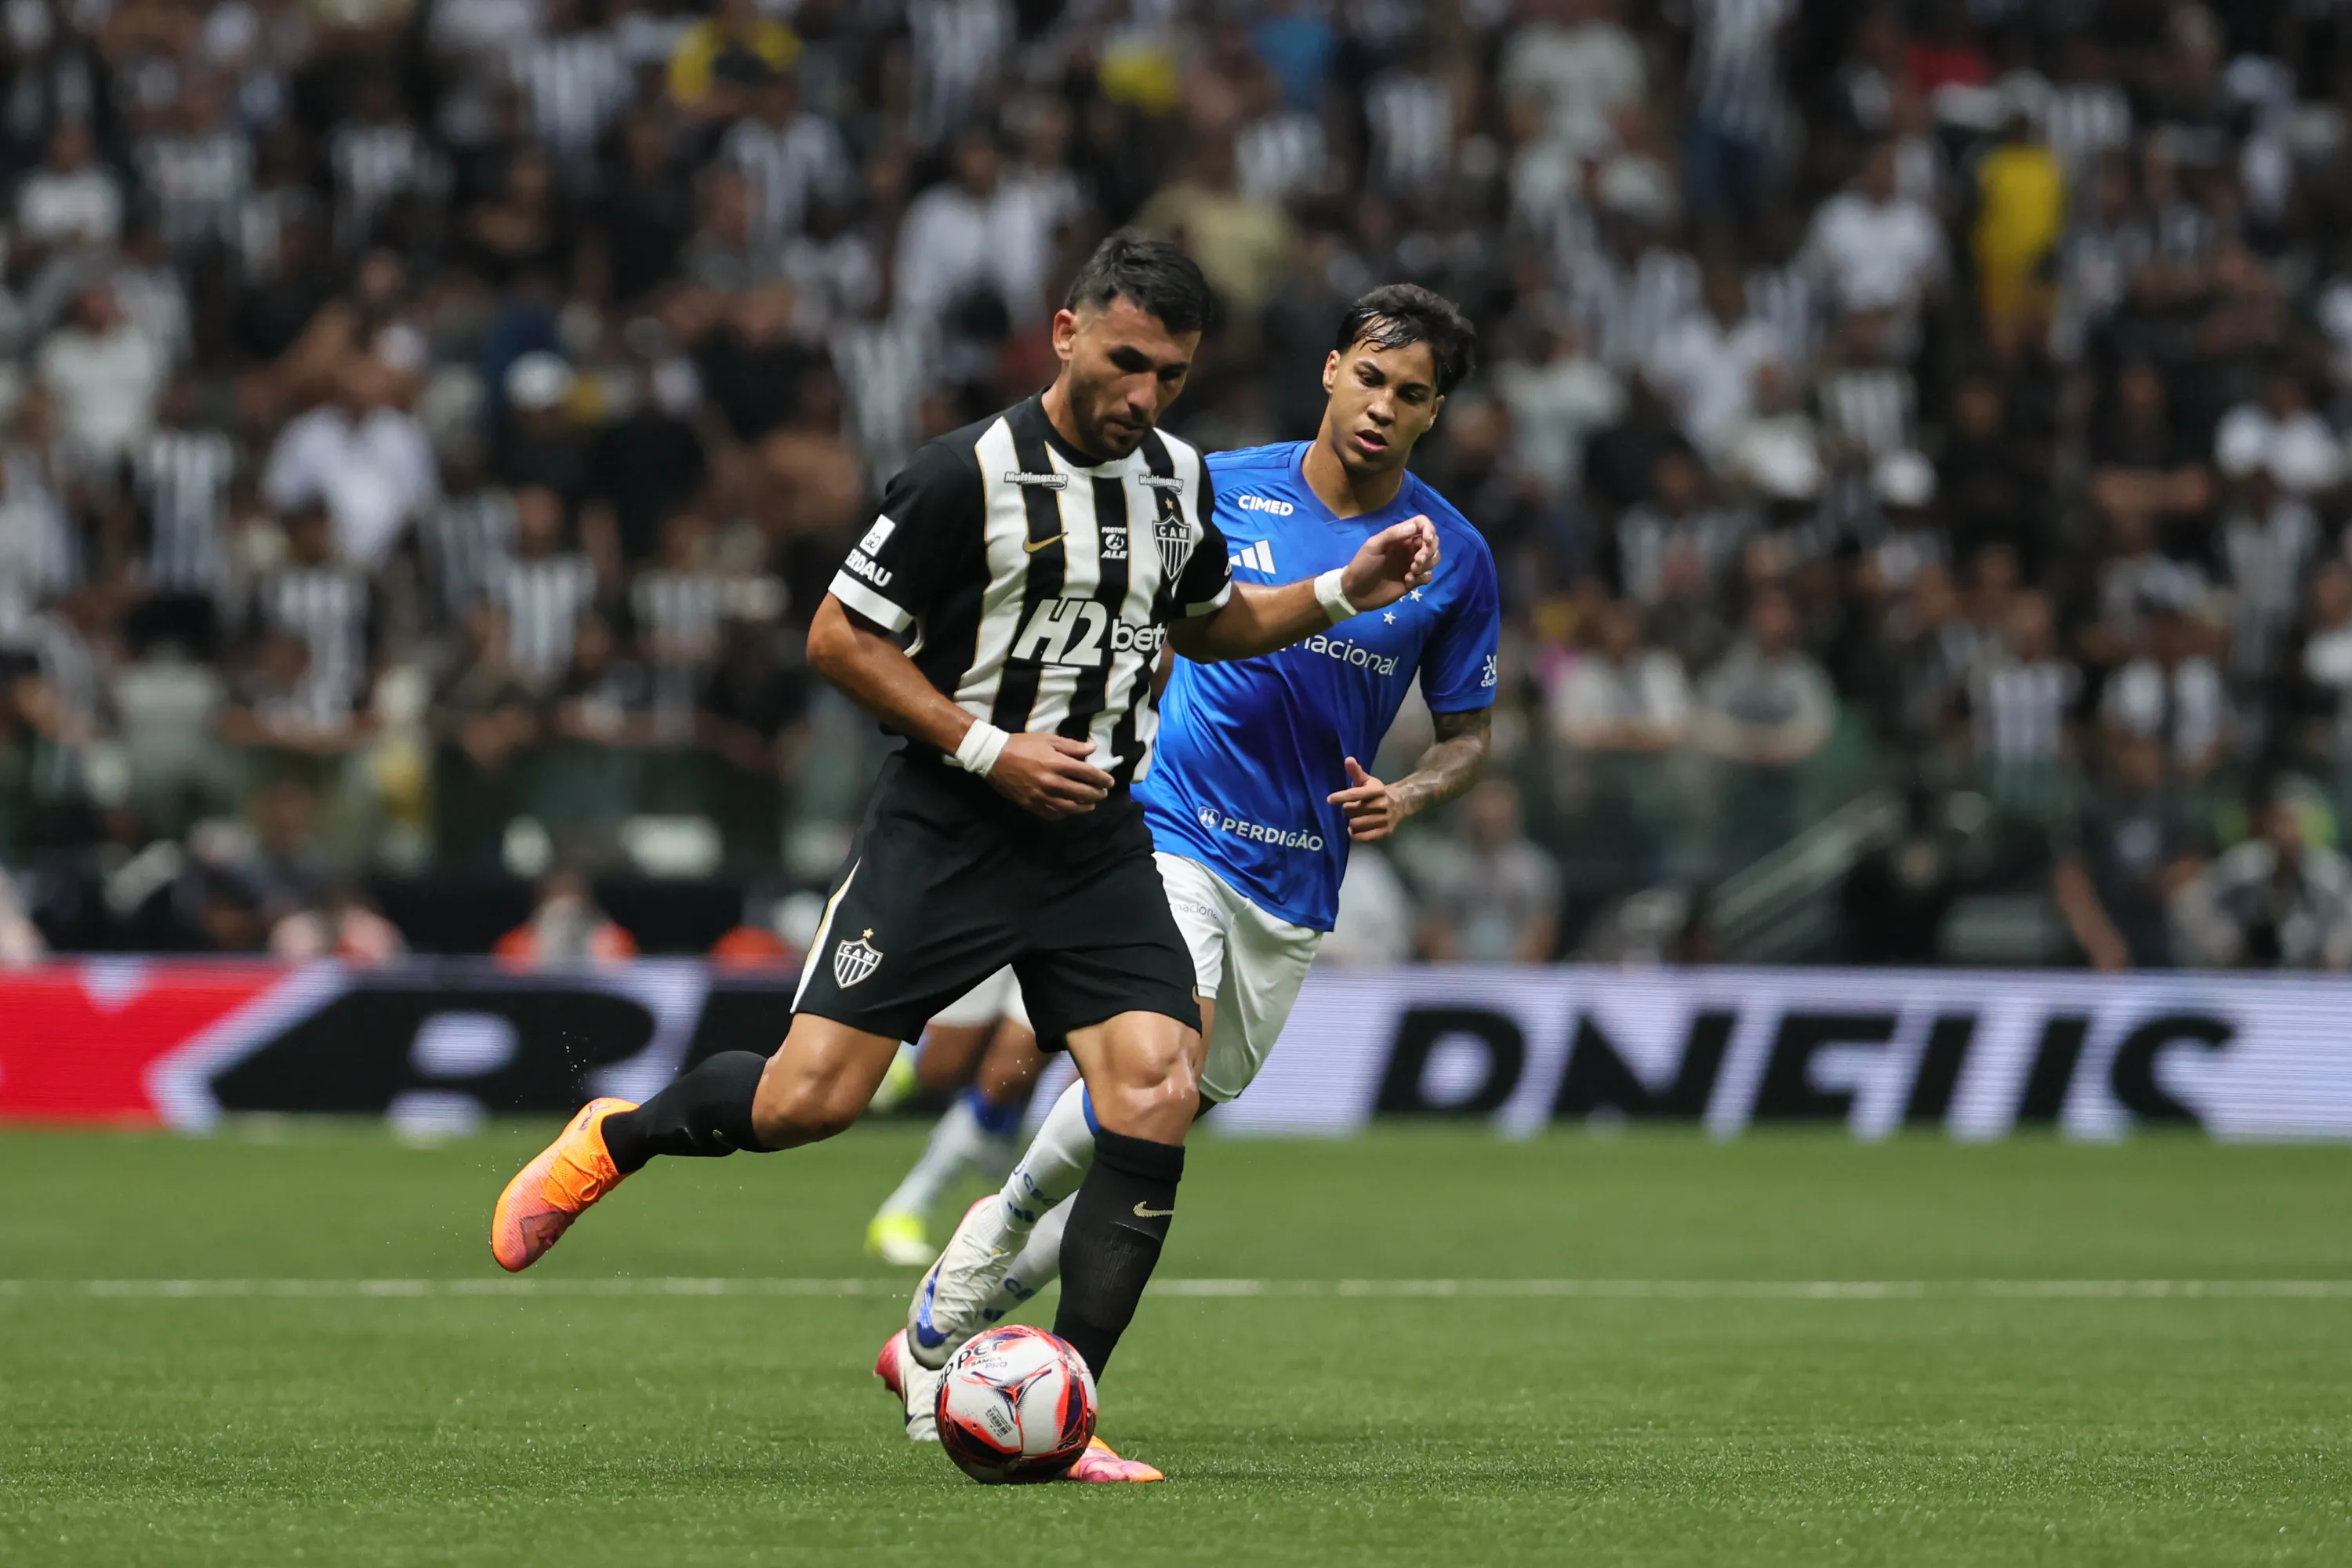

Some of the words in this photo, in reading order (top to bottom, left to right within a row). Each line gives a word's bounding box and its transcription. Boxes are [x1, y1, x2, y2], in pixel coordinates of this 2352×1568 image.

[1239, 495, 1294, 516] CIMED
[1159, 526, 1187, 539] CAM
[1101, 550, 1127, 559] ALE
[844, 548, 893, 587] ERDAU
[1221, 818, 1323, 851] PERDIGÃO
[843, 946, 875, 962] CAM
